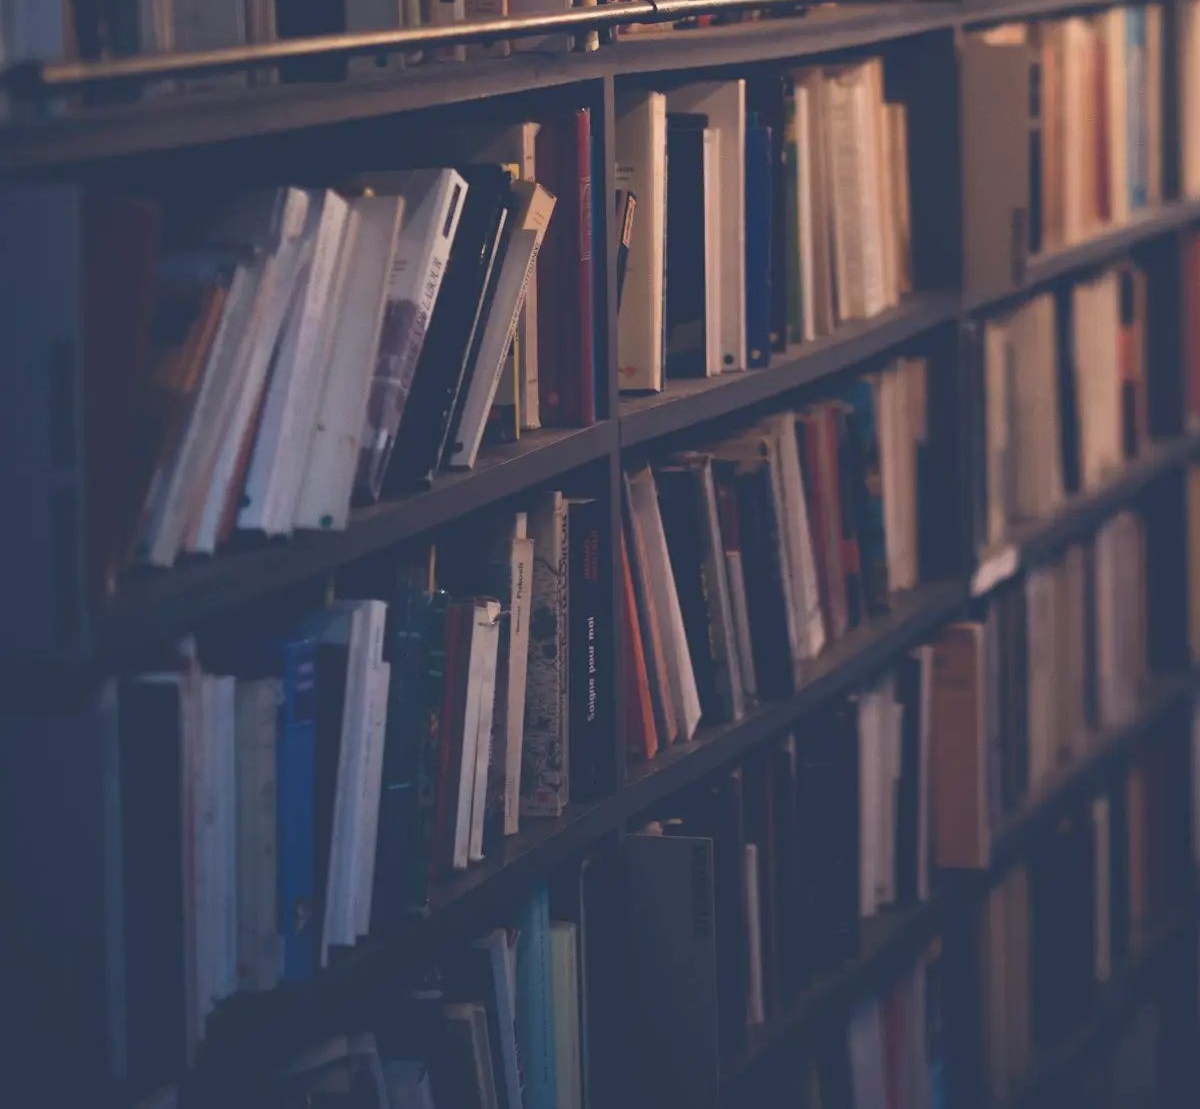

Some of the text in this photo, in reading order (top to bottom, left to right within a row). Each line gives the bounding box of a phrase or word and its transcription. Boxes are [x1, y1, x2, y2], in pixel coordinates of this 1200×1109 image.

[586, 616, 597, 722] Saigne pour moi
